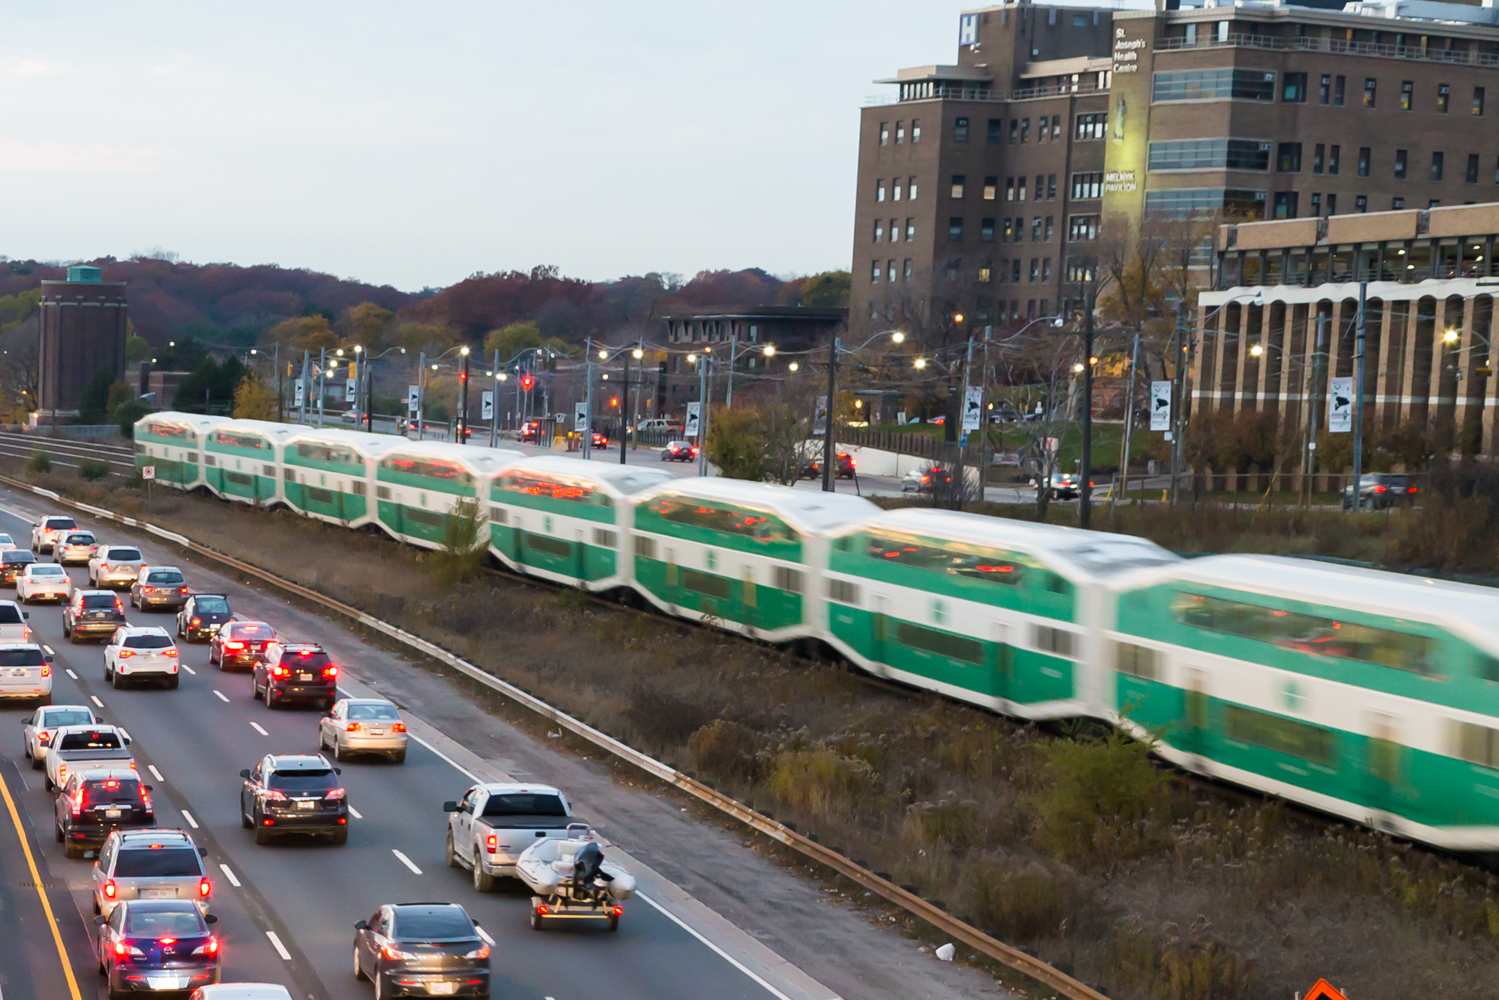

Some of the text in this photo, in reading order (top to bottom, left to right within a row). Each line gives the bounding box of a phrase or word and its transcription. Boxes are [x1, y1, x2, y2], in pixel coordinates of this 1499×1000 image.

[962, 17, 976, 44] H
[1114, 38, 1146, 50] Joseph's
[1114, 51, 1137, 61] Health
[1113, 64, 1137, 73] Centre
[1106, 172, 1134, 182] MELNYK
[1104, 182, 1137, 193] PAVILION
